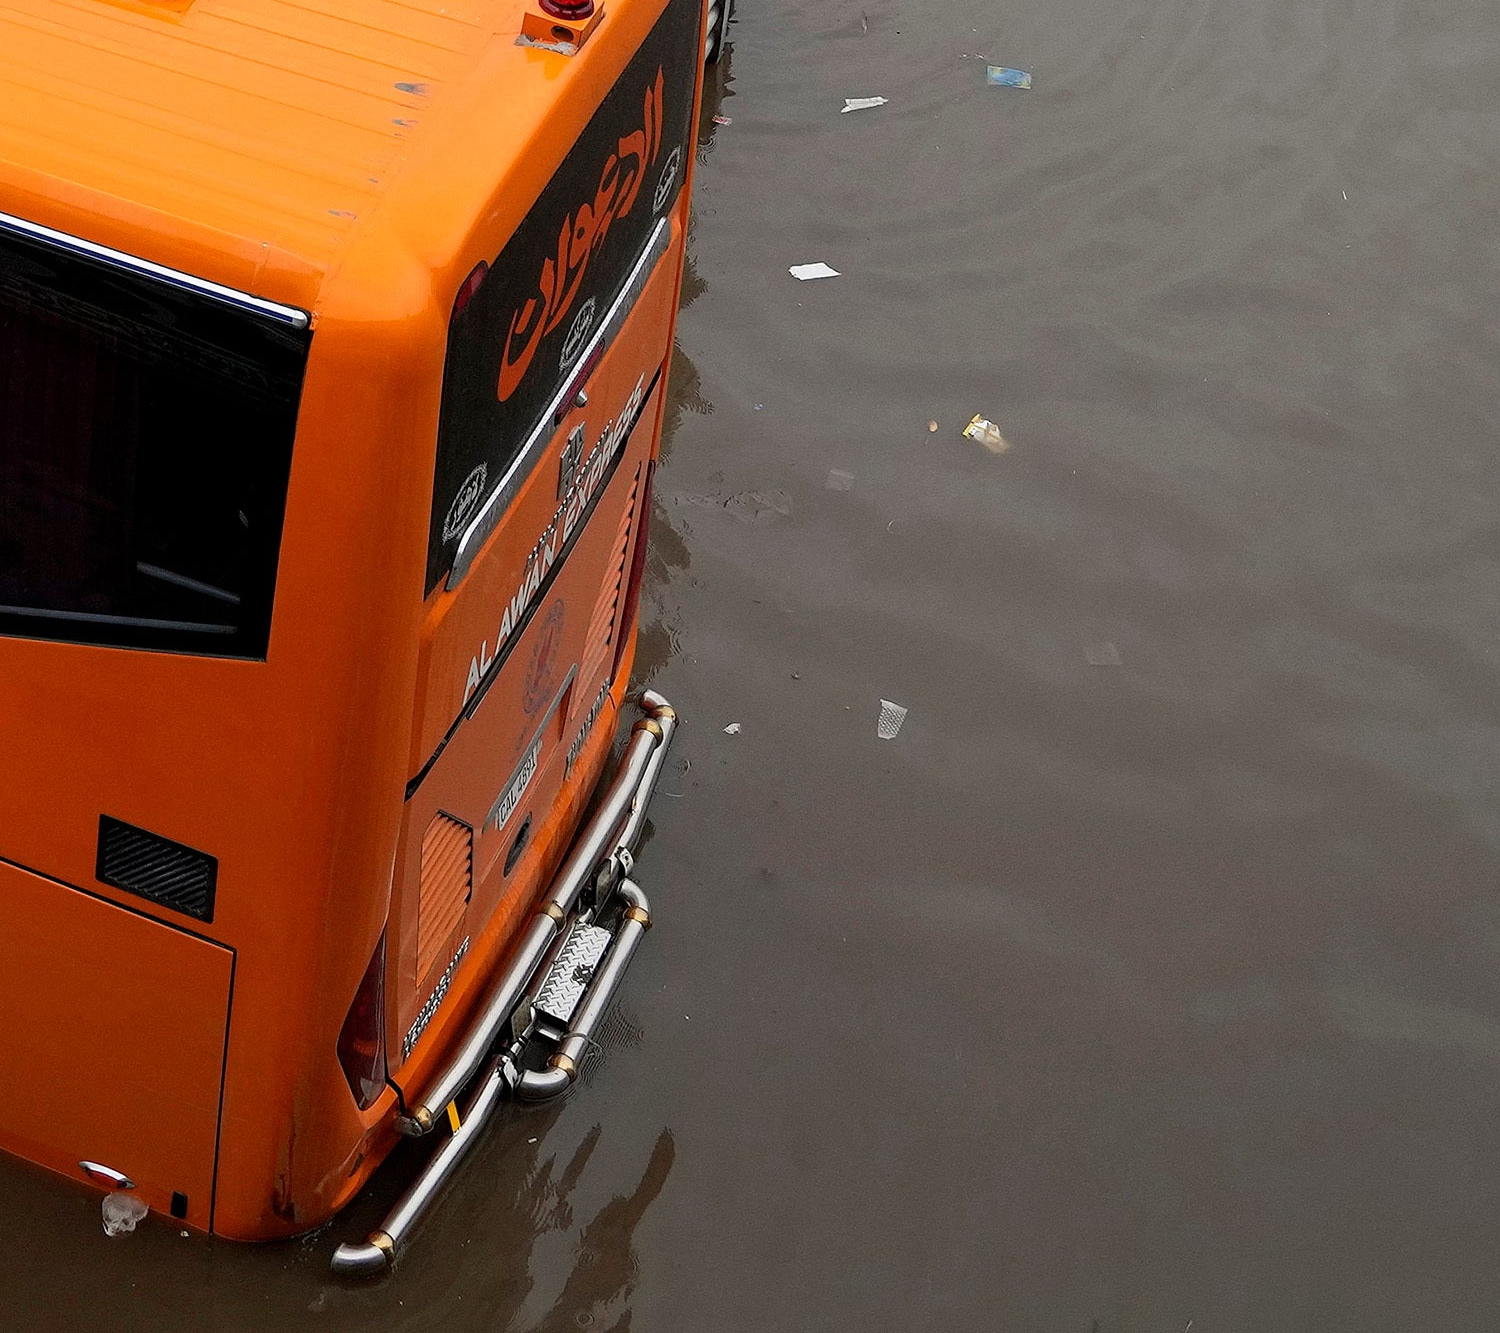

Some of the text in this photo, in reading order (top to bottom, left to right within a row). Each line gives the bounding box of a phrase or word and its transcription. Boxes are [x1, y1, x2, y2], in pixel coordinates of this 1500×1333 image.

[461, 638, 494, 709] AL
[494, 542, 557, 657] AWAN
[559, 373, 647, 546] EXPRESS
[498, 791, 519, 826] CAL
